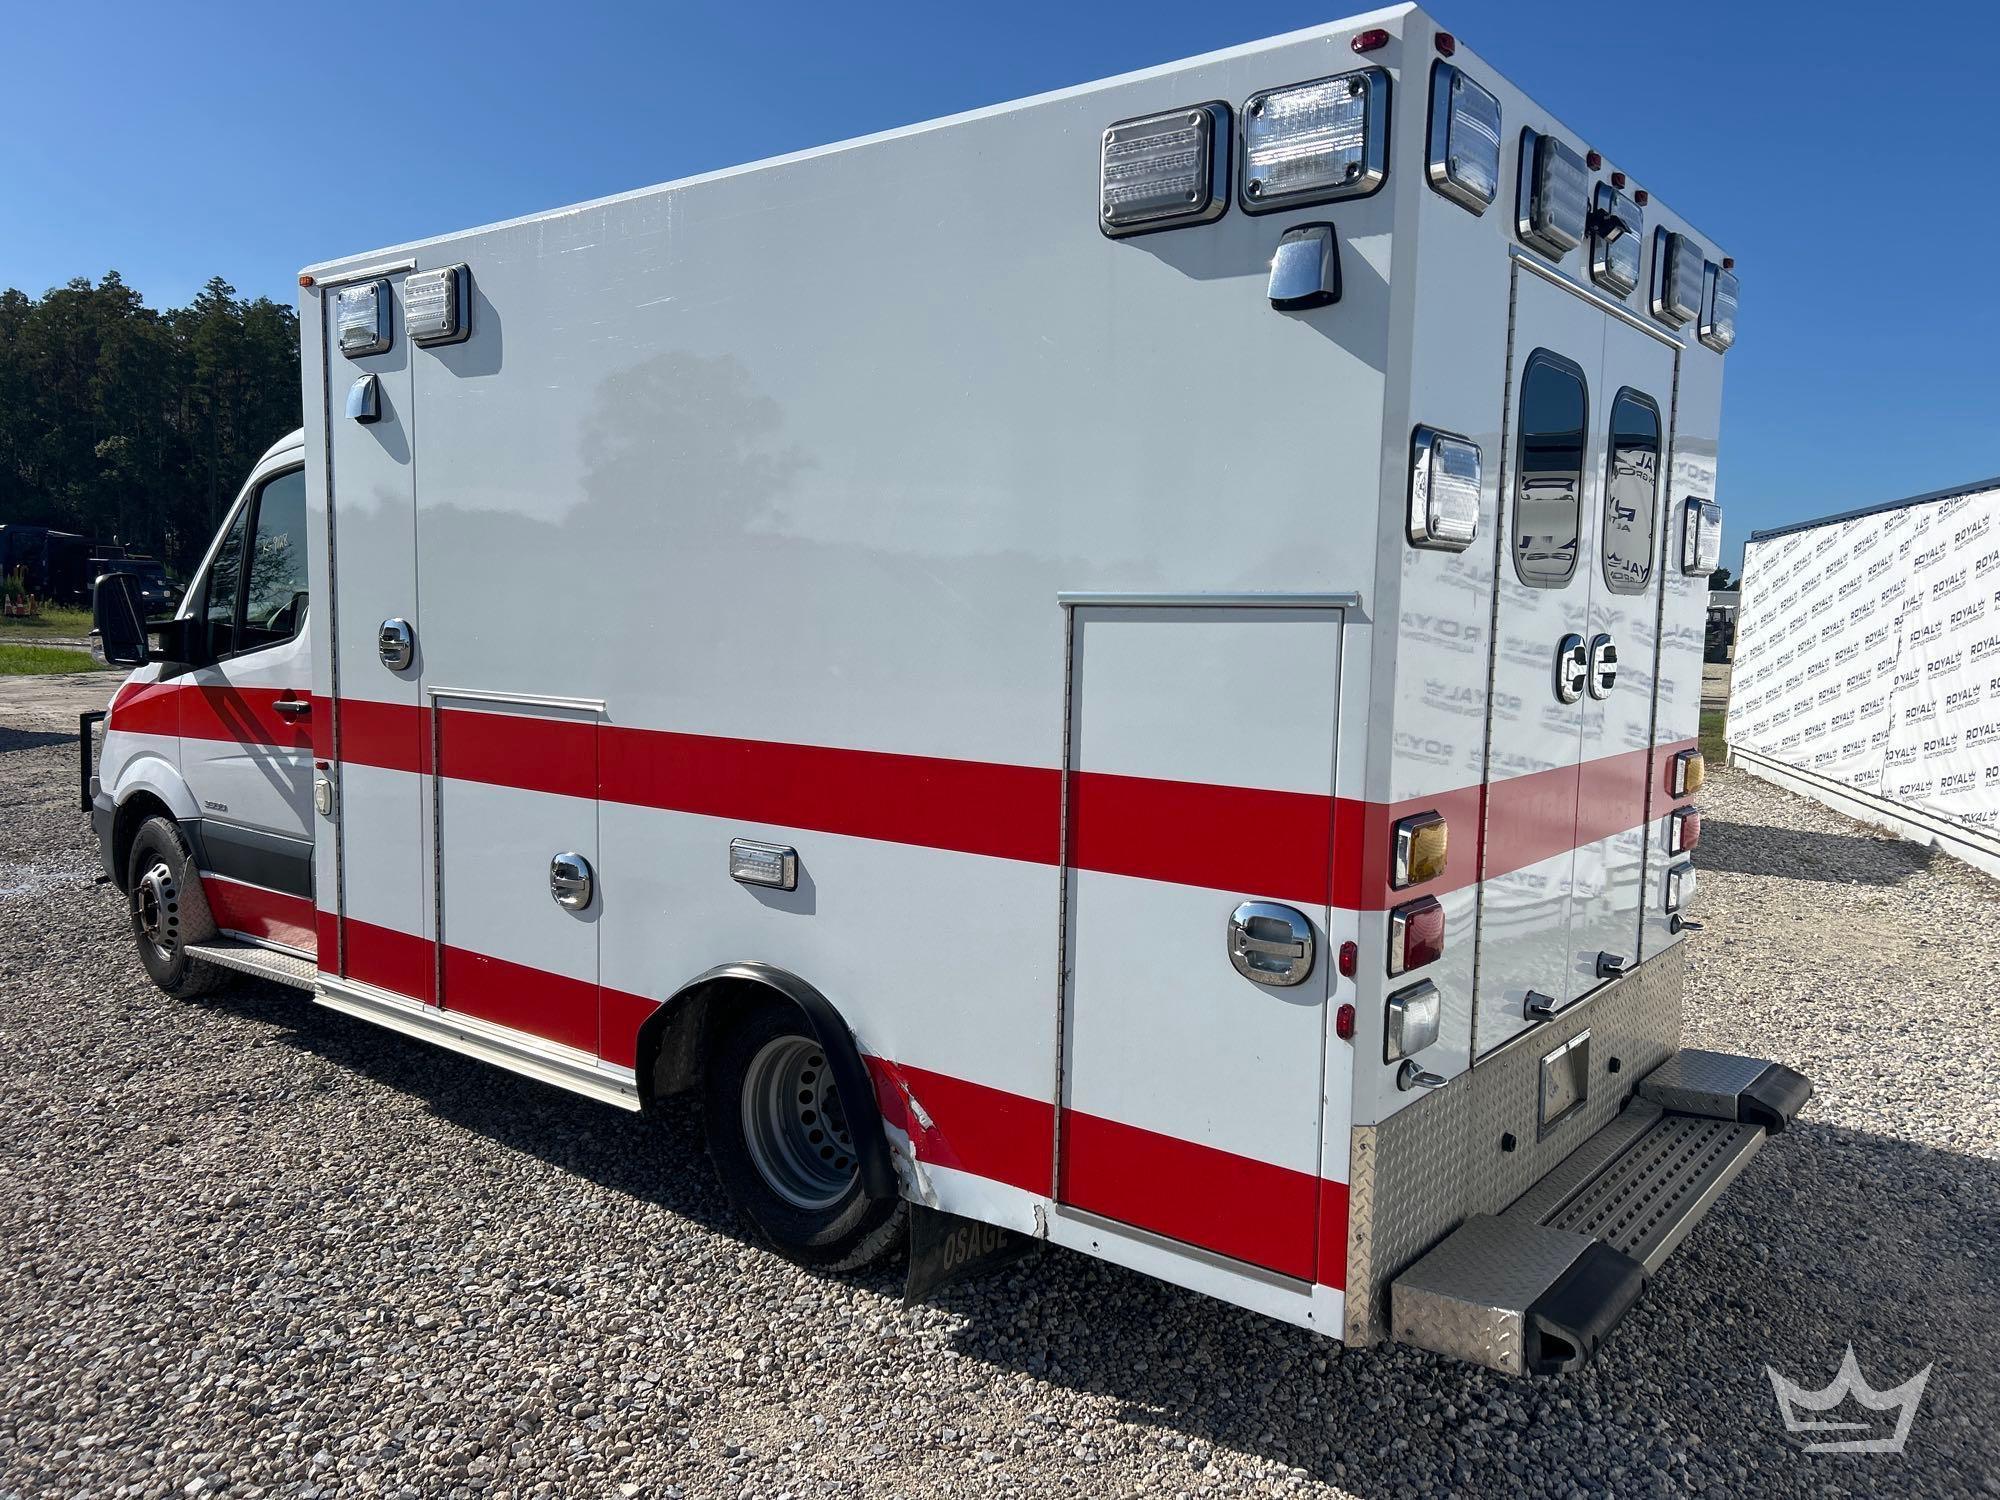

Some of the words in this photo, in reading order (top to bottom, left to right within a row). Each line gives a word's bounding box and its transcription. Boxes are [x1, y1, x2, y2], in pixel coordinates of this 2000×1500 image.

[1884, 508, 1905, 530] ROYAL
[1955, 519, 1983, 544] ROYAL
[1816, 535, 1833, 552] ROYAL
[1854, 533, 1873, 553] ROYAL
[1914, 546, 1940, 567] ROYAL
[1976, 549, 1999, 572] ROYA
[1826, 556, 1844, 574] ROYAL
[1868, 556, 1889, 576] ROYAL
[1839, 578, 1858, 595] ROYAL
[1882, 581, 1901, 601] ROYAL
[1933, 573, 1959, 595] ROYAL
[1811, 599, 1828, 613] ROYAL
[1851, 603, 1870, 619] ROYAL
[1951, 603, 1977, 624] ROYAL
[1822, 621, 1840, 636] ROYAL
[1865, 628, 1885, 644] ROYAL
[1835, 645, 1854, 660] ROYAL
[1971, 634, 2000, 656] ROYAL
[1808, 661, 1824, 674] ROYAL
[1928, 654, 1955, 672] ROYAL
[1847, 671, 1867, 686] ROYAL
[1819, 687, 1836, 700] ROYAL
[1946, 688, 1973, 706] ROYAL
[1861, 700, 1880, 713] ROYAL
[1906, 703, 1931, 719] ROYAL
[1832, 712, 1850, 725] ROYAL
[1805, 725, 1821, 736] ROYAL
[1872, 730, 1889, 743] ROYA
[1966, 722, 1995, 741] ROYAL
[1843, 741, 1861, 753] ROYAL
[1924, 736, 1950, 752] ROYAL
[1816, 752, 1833, 763] ROYAL
[1855, 771, 1875, 782] ROYAL
[1941, 774, 1967, 788] ROYAL
[1900, 782, 1925, 796] ROYAL
[943, 1224, 1008, 1271] OSAGE
